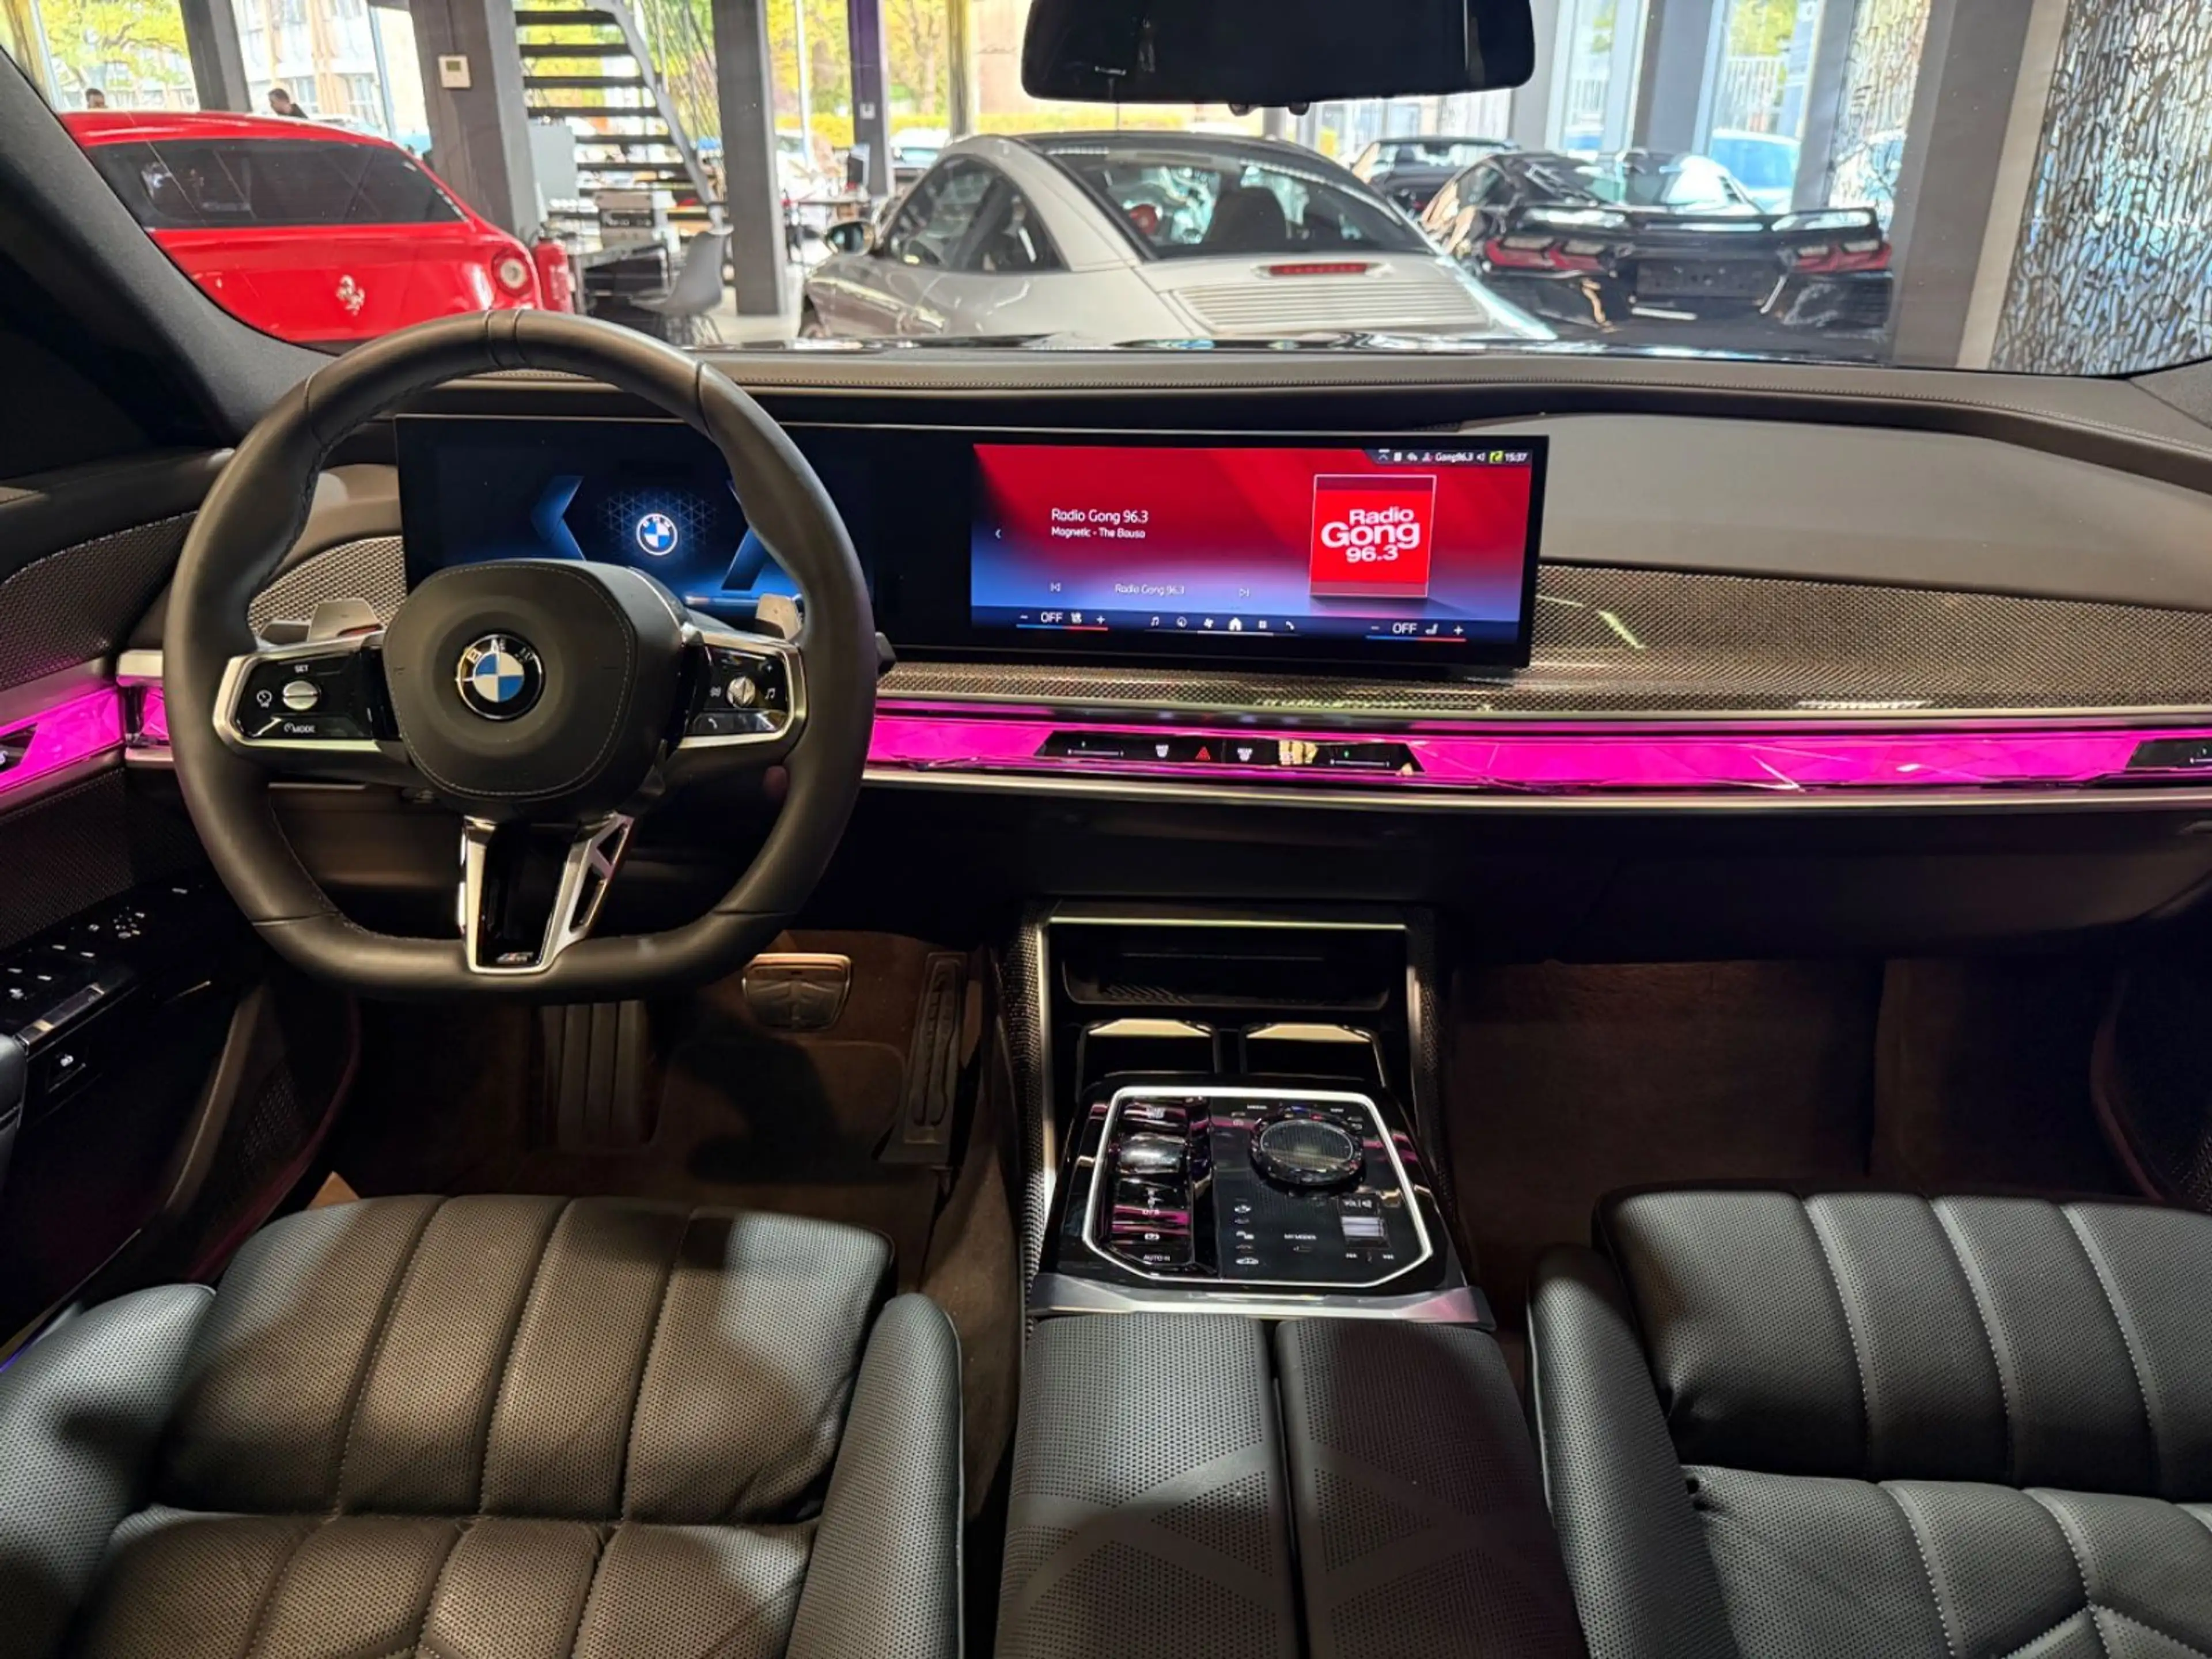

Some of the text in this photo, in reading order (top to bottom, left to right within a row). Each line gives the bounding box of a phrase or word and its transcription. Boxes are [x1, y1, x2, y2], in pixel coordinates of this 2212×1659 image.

[1051, 507, 1149, 525] Radio Gong 96.3
[1349, 506, 1415, 526] Radio
[1051, 526, 1092, 539] Magnetic
[1099, 527, 1115, 537] The
[1321, 521, 1421, 550] Gong
[1346, 544, 1399, 563] 96.3
[1115, 583, 1138, 594] Radio
[1141, 584, 1165, 596] Gong
[1040, 611, 1063, 623] OFF
[1392, 622, 1418, 634] OFF
